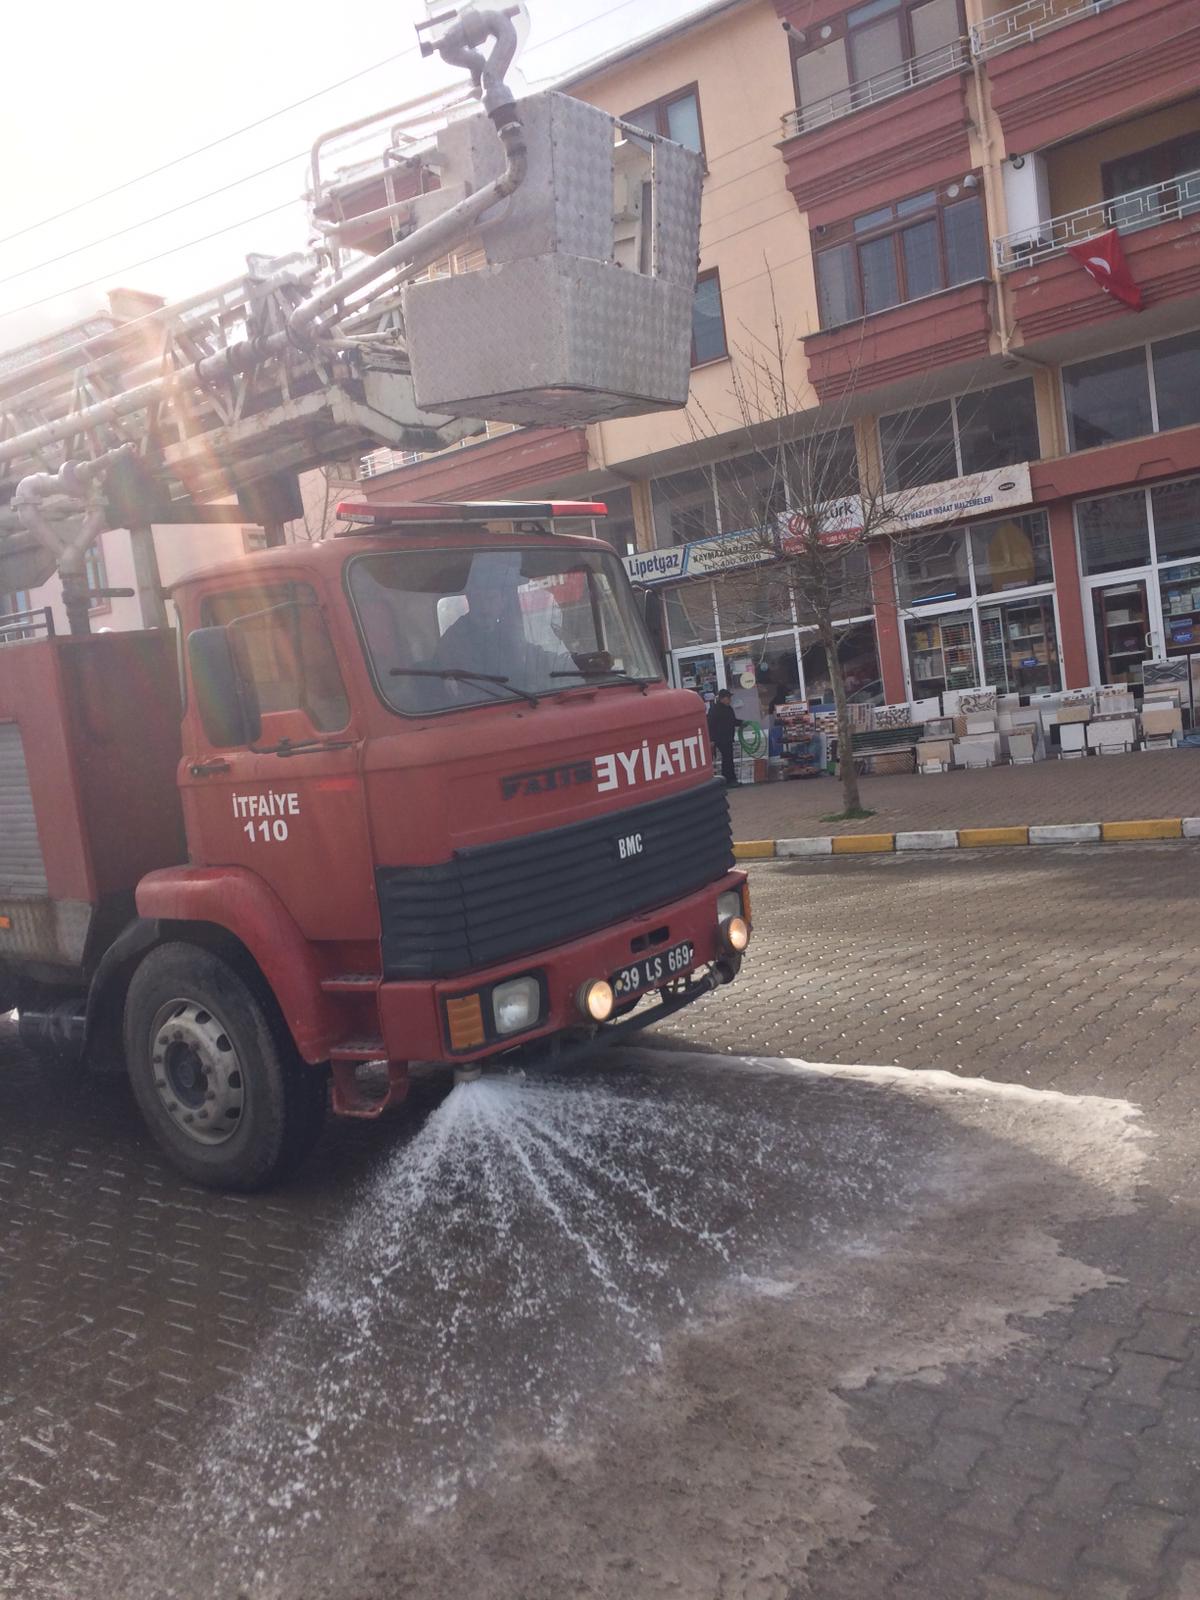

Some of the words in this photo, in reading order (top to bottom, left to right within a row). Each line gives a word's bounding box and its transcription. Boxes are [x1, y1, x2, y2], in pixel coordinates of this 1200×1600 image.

[629, 552, 680, 578] Lipetgaz
[232, 790, 300, 818] İTFAİYE
[244, 819, 288, 842] 110
[618, 833, 643, 859] BMC
[621, 967, 640, 991] 39
[645, 957, 662, 981] LS
[668, 945, 690, 971] 669
